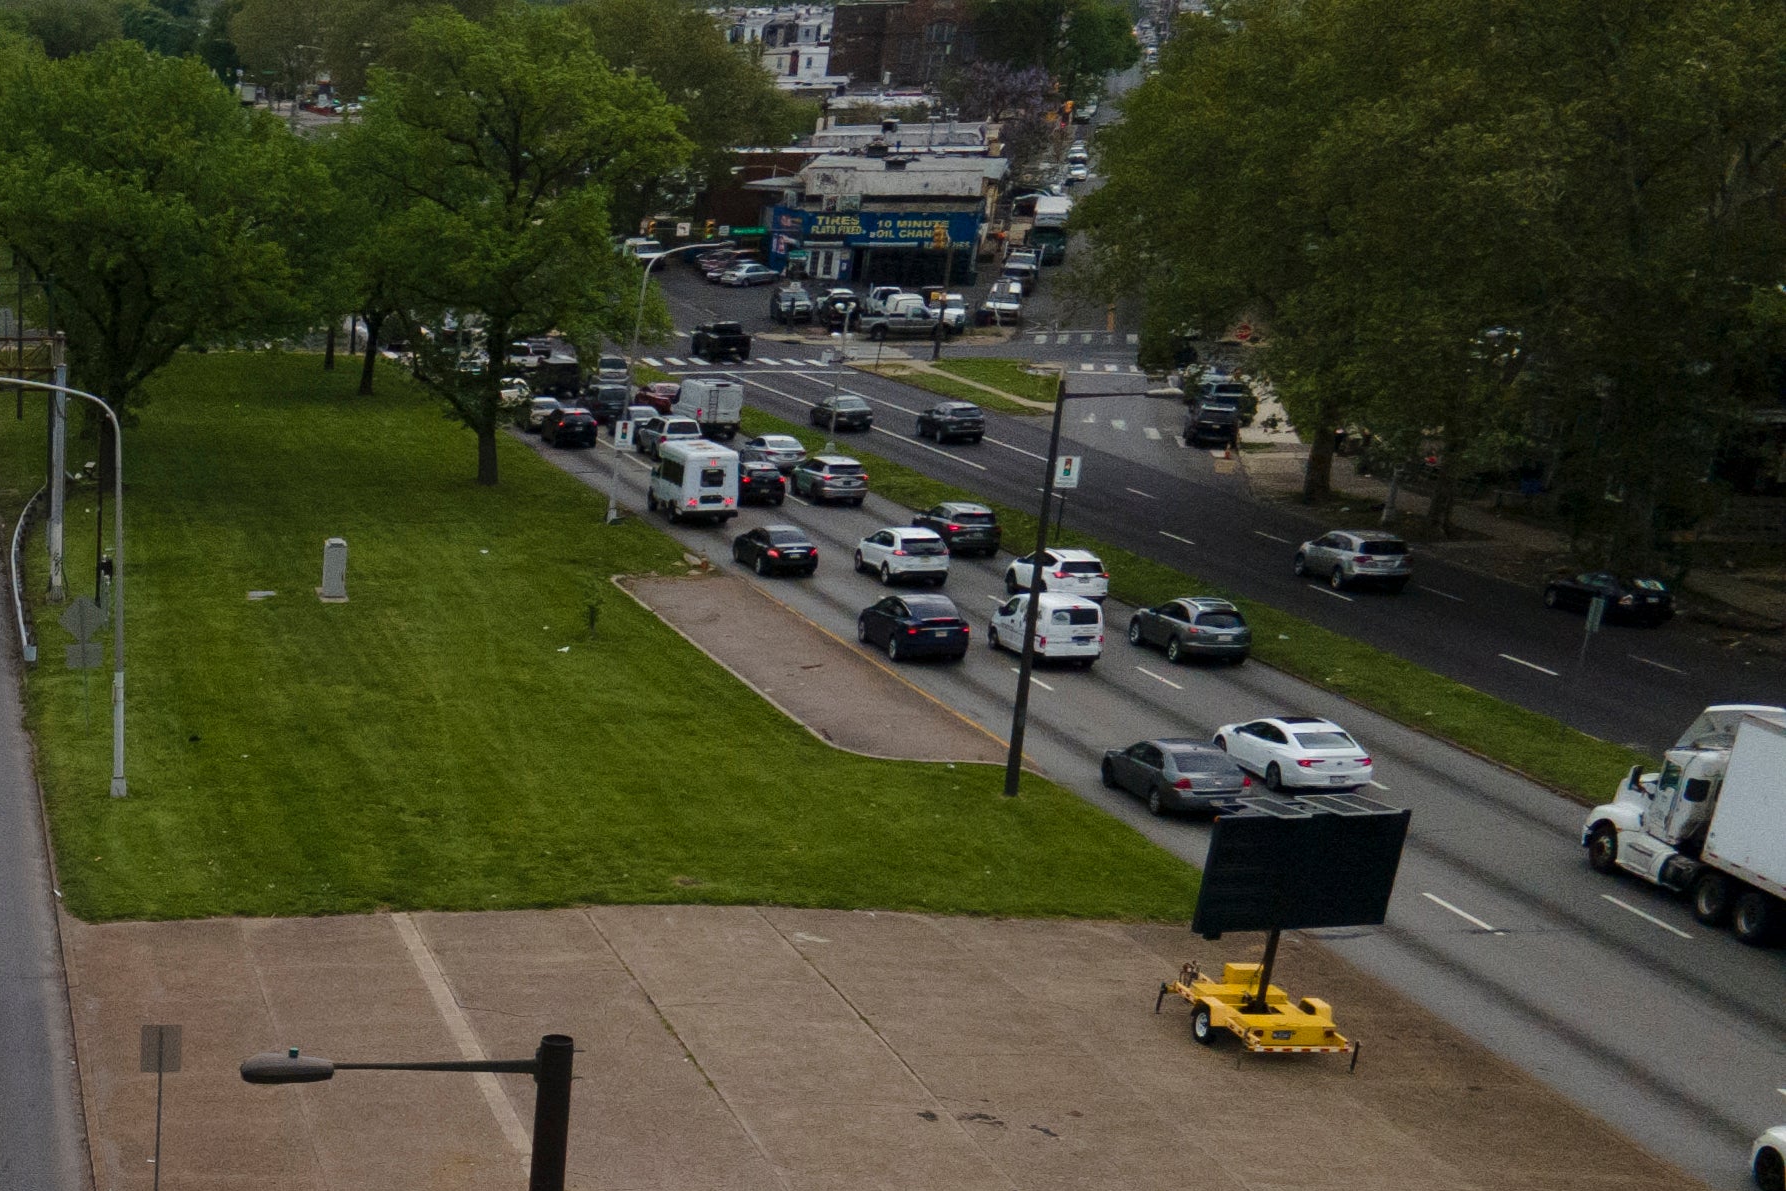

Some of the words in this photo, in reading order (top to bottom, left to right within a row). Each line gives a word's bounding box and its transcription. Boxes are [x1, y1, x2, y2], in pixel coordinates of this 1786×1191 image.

[816, 216, 860, 225] TIRES
[877, 220, 892, 228] 10
[897, 220, 949, 228] MINUTE
[898, 230, 939, 238] CHAN
